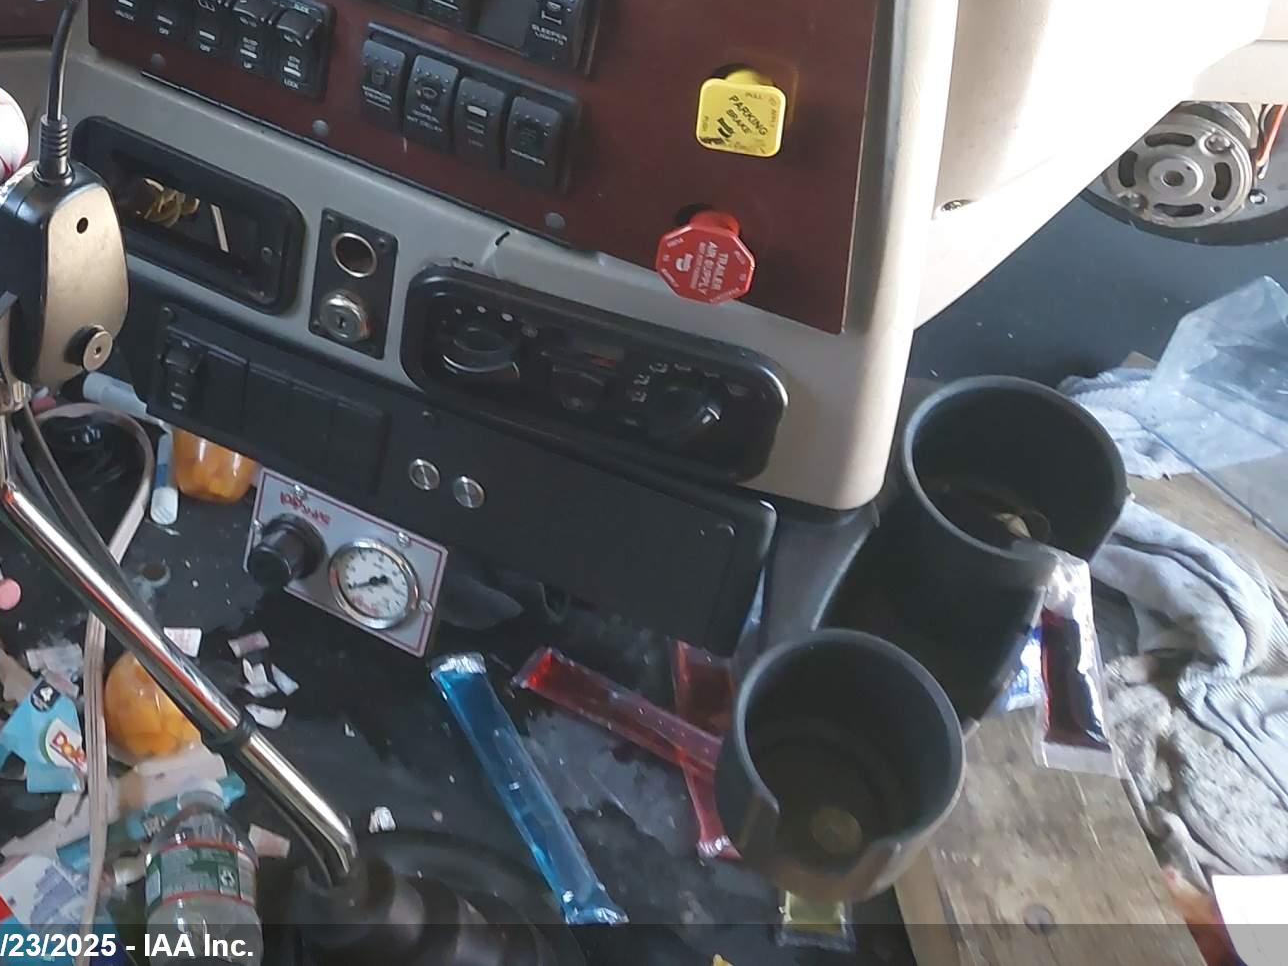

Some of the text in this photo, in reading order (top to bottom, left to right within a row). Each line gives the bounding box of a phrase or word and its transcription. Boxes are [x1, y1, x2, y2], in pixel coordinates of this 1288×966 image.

[531, 23, 568, 42] SLEEPER
[534, 31, 565, 46] LIGHTS
[283, 78, 300, 90] LOCK
[725, 109, 752, 135] BRAKE
[728, 95, 769, 136] PARKING
[705, 241, 719, 258] AIR
[697, 259, 715, 295] SUPPLY
[712, 253, 729, 291] TRAILER
